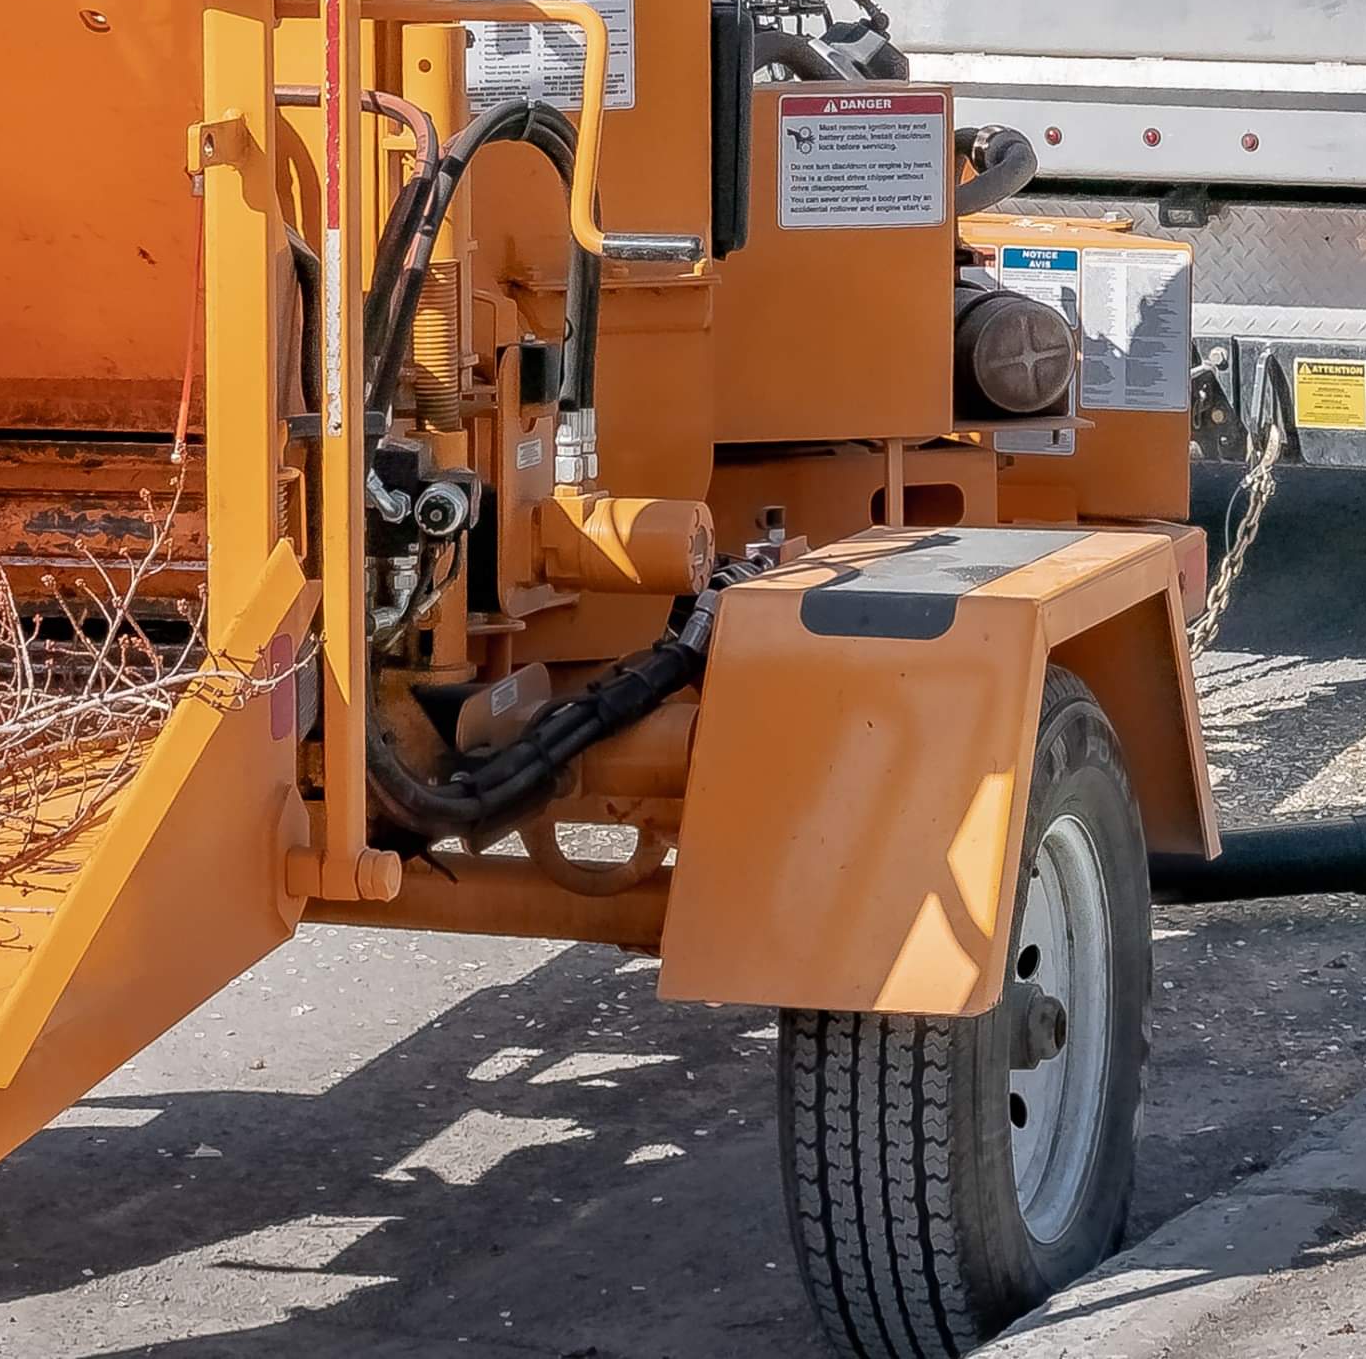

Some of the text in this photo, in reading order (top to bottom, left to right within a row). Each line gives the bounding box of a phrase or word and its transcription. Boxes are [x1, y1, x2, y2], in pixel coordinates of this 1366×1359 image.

[839, 98, 892, 110] DANGER
[1021, 250, 1059, 260] NOTICE
[1028, 260, 1052, 269] AVIS
[1312, 365, 1364, 375] ATTENTION
